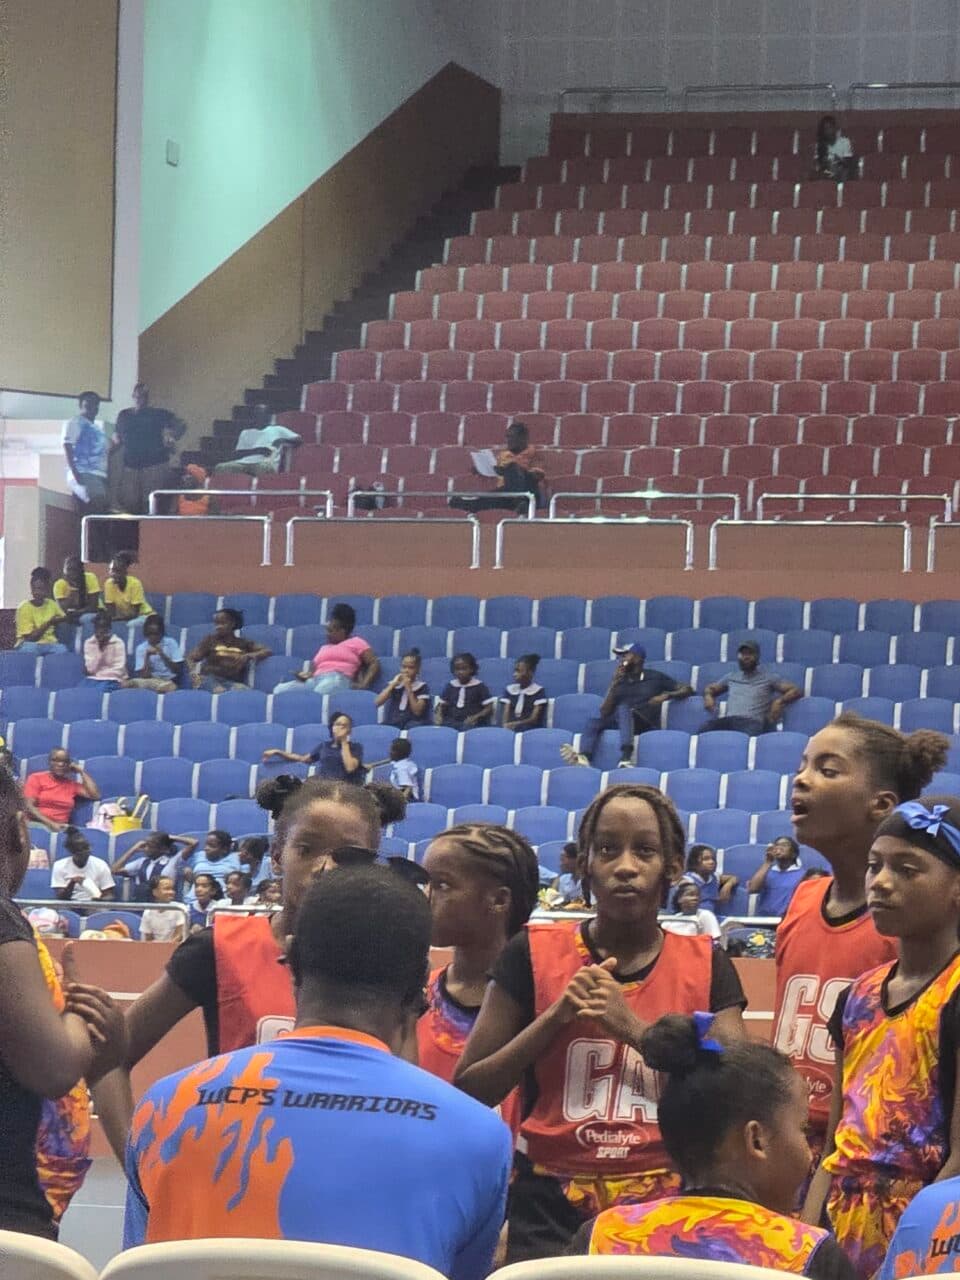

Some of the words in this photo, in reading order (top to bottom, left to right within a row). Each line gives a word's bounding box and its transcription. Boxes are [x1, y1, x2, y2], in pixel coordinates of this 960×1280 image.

[563, 1038, 659, 1123] GA
[197, 1086, 278, 1107] WCPS
[283, 1090, 437, 1121] WARRIORS
[584, 1128, 641, 1146] Pedialyte
